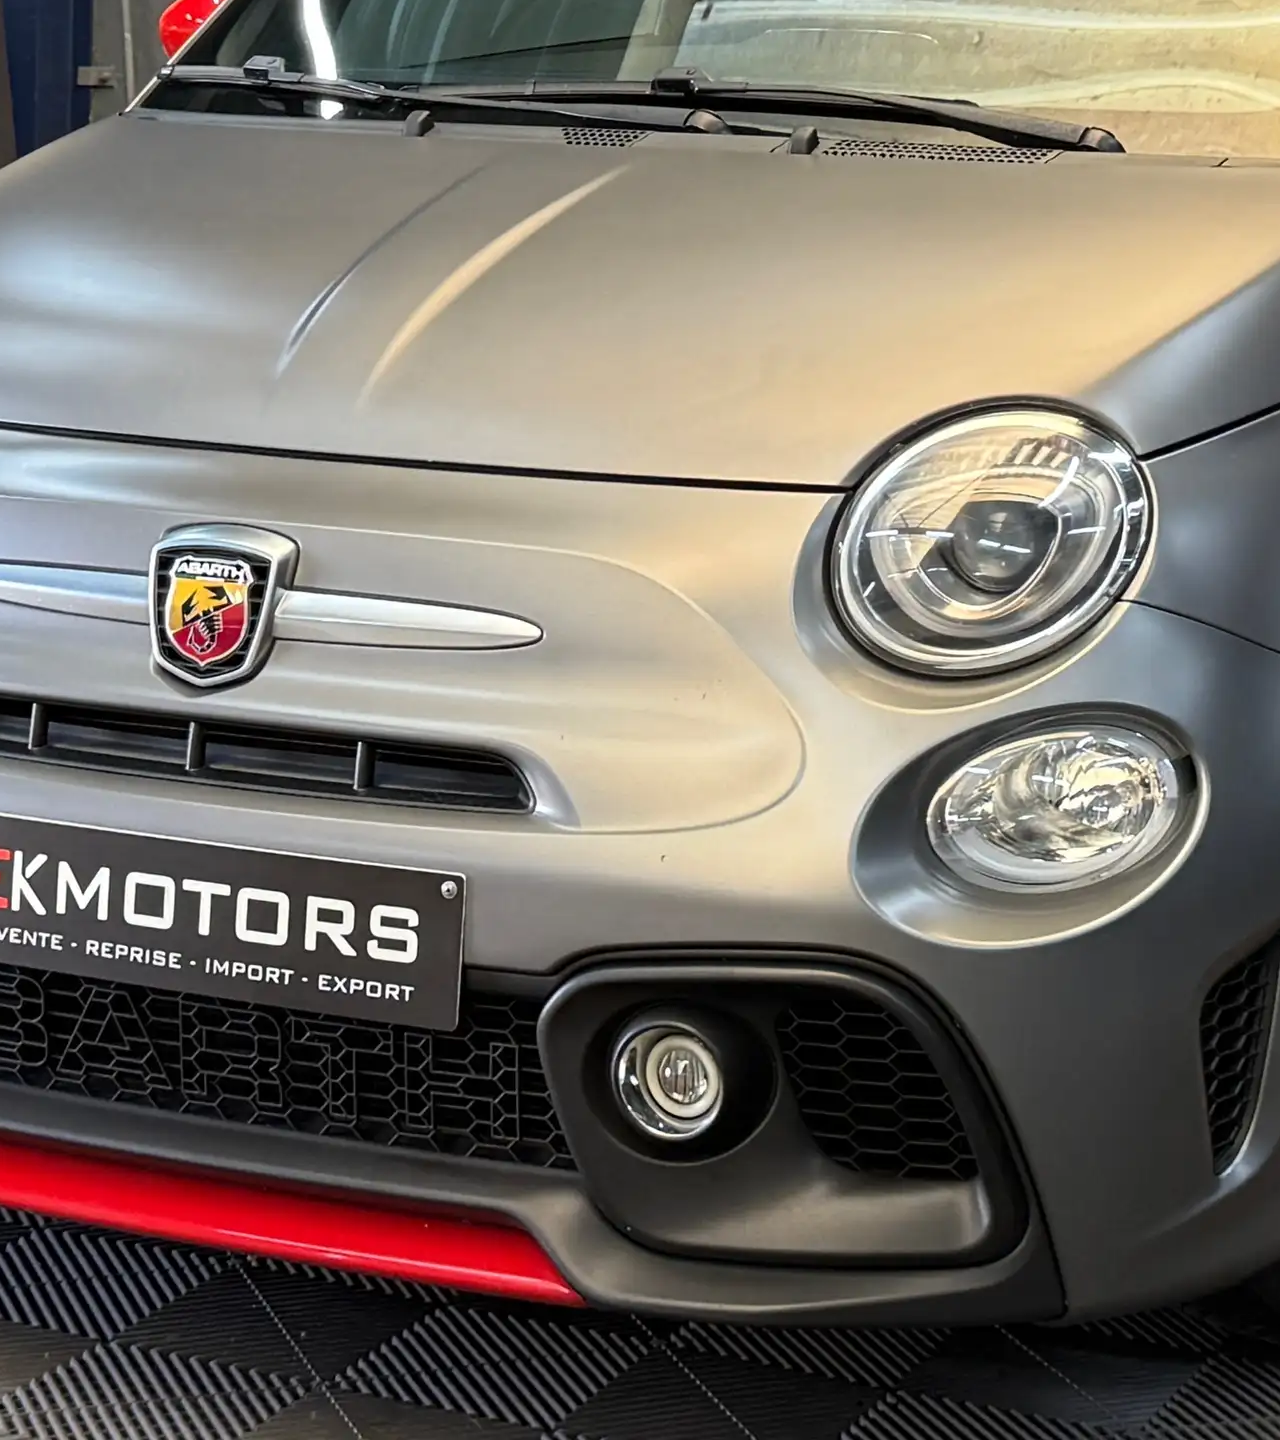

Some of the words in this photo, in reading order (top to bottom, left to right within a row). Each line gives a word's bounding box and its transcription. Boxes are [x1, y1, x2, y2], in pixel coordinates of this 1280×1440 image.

[176, 561, 246, 584] ABARTH
[86, 939, 183, 970] REPRISE
[204, 957, 294, 986] IMPORT
[318, 974, 415, 1003] EXPORT
